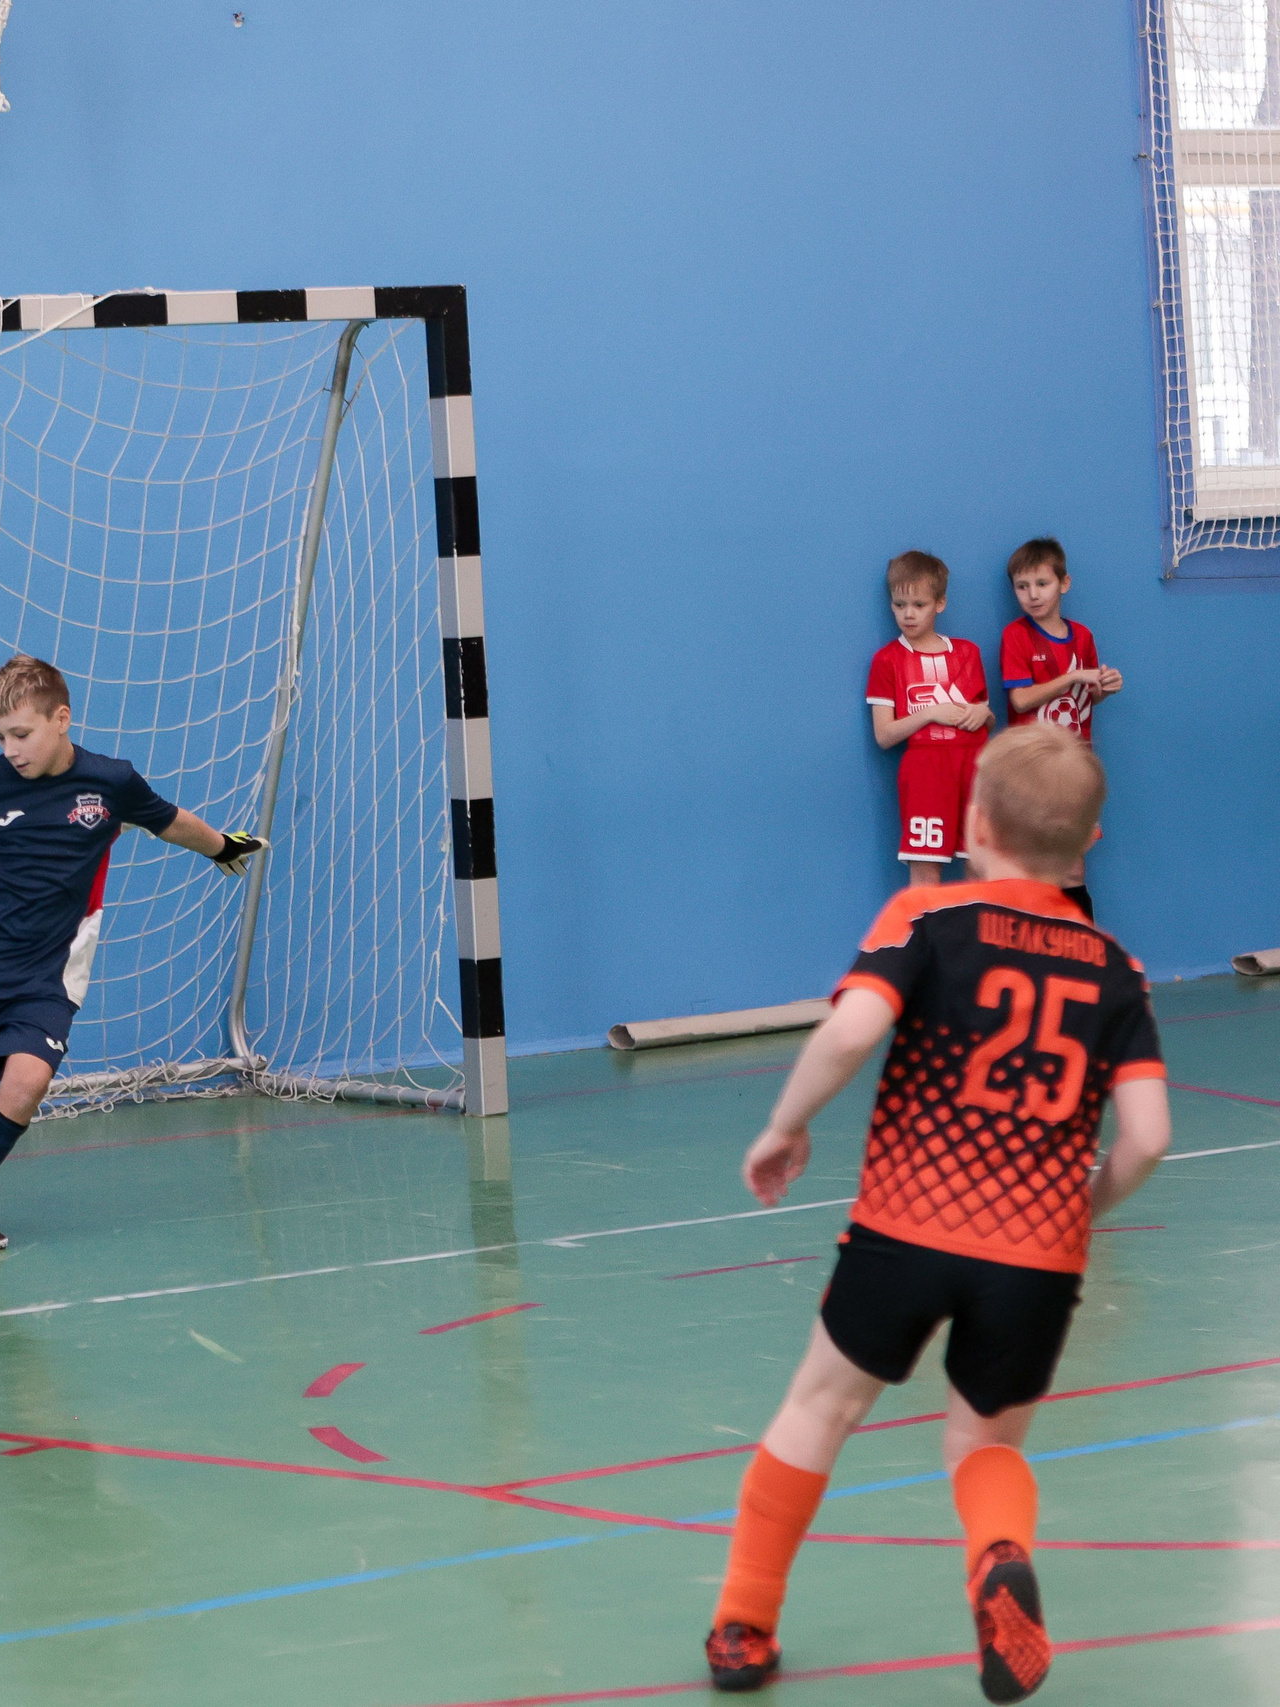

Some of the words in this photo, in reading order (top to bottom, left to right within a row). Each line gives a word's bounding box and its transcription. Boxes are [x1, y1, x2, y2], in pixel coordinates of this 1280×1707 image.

[76, 805, 104, 815] ФАКТУМ
[908, 815, 944, 849] 96
[952, 966, 1101, 1123] 25
